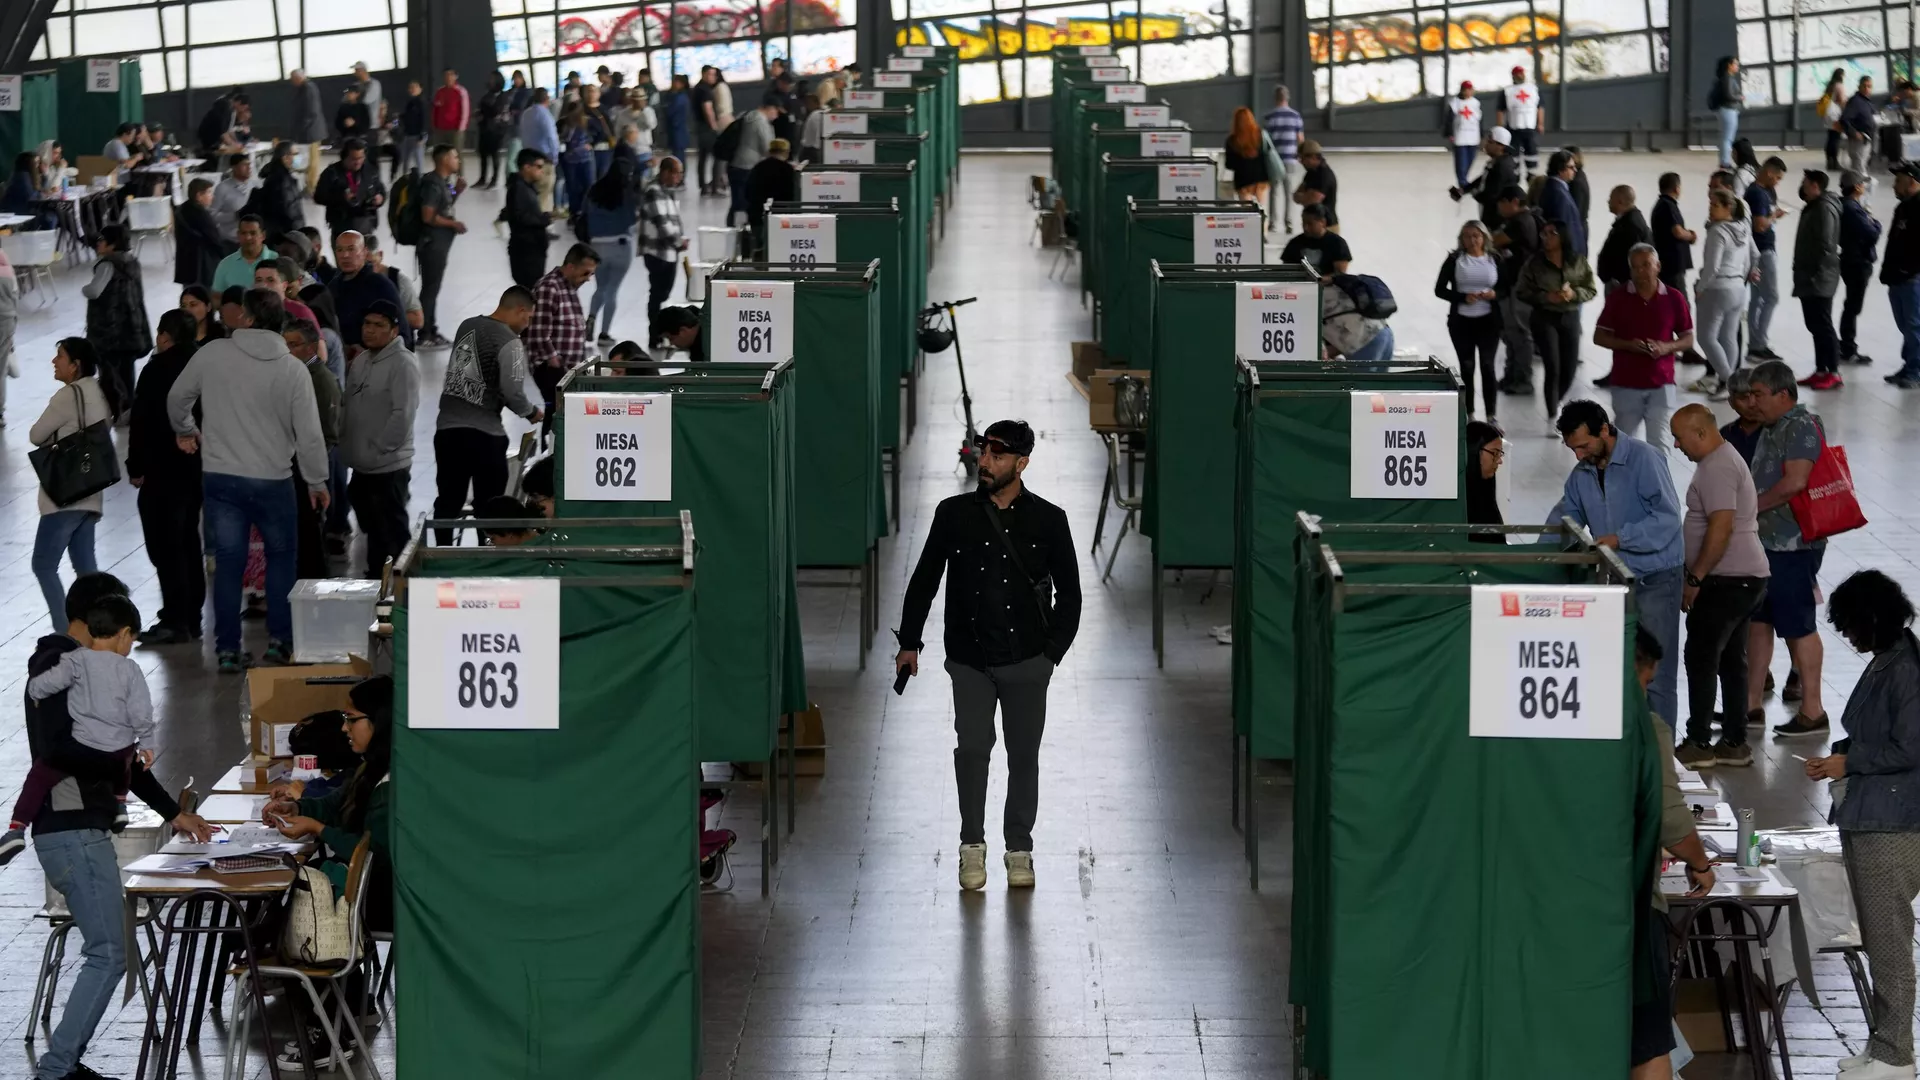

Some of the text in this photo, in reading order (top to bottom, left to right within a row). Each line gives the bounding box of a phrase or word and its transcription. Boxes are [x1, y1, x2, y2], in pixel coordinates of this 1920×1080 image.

[790, 239, 816, 249] MESA
[1214, 238, 1242, 248] MESA
[739, 310, 772, 322] MESA
[1262, 312, 1295, 324] MESA
[738, 326, 772, 353] 861
[1262, 329, 1295, 354] 866
[596, 433, 639, 450] MESA
[1384, 430, 1427, 449] MESA
[595, 456, 637, 487] 862
[1384, 455, 1428, 486] 865
[461, 633, 521, 653] MESA
[1518, 641, 1580, 669] MESA
[458, 661, 519, 709] 863
[1519, 676, 1581, 720] 864
